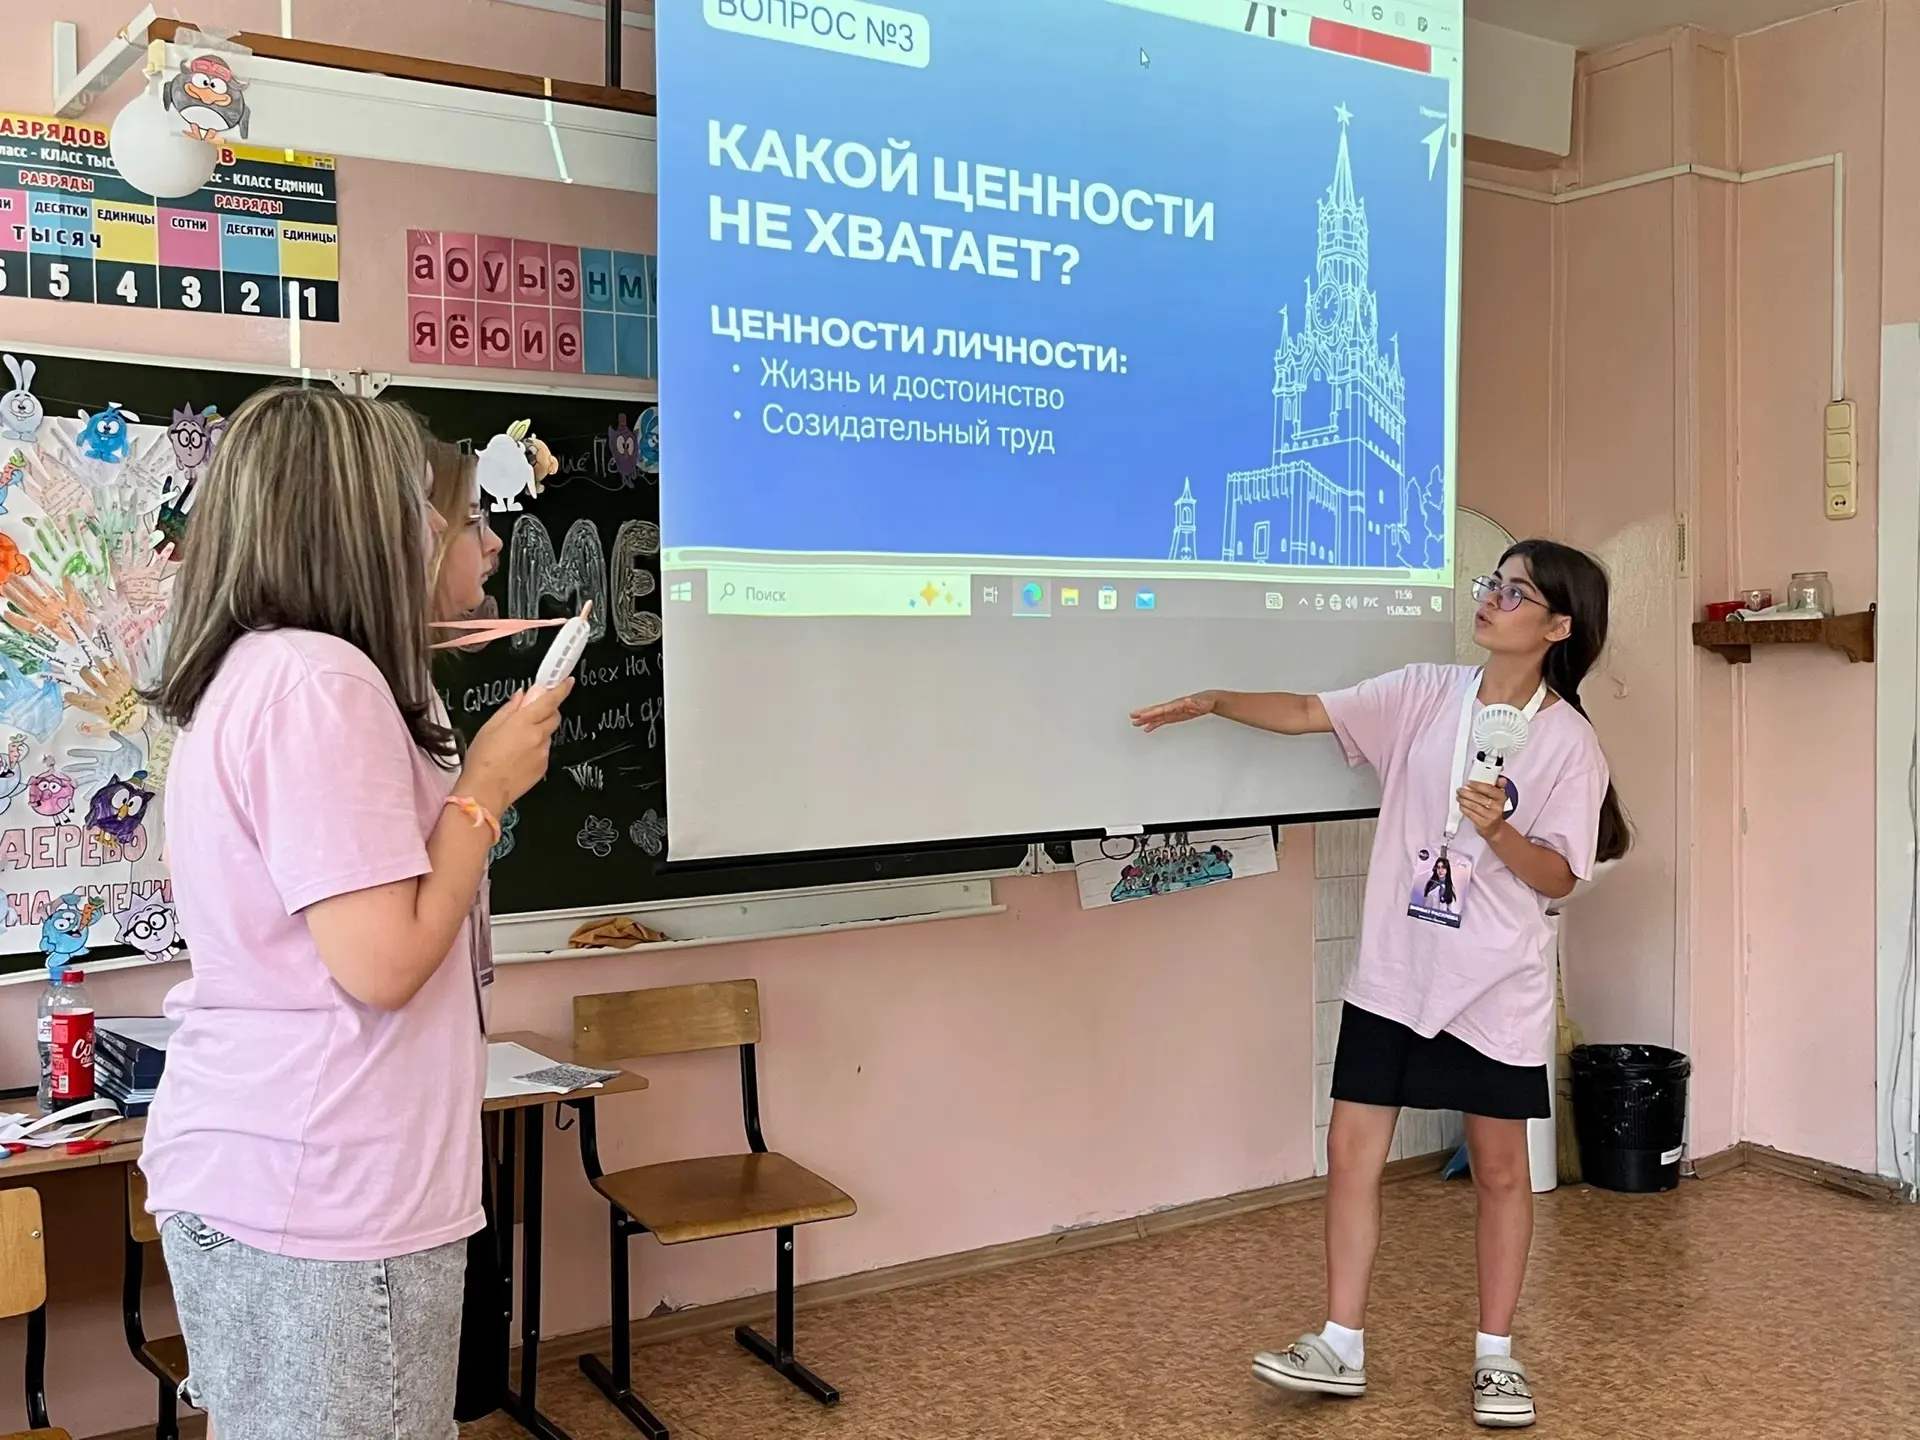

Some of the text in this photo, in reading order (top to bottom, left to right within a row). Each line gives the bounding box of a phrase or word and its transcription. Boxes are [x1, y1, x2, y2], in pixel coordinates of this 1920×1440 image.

[718, 0, 914, 52] ВОПРОС №3
[0, 118, 107, 147] АЗРЯДОВ
[41, 148, 83, 165] КЛАСС
[86, 154, 117, 169] ТЫС
[20, 171, 93, 192] РАЗРЯДЫ
[233, 173, 272, 188] КЛАСС
[274, 178, 324, 196] ЕДИНИЦ
[708, 118, 1215, 241] КАКОЙ ЦЕННОСТИ
[34, 201, 88, 217] ДЕСЯТКИ
[216, 195, 282, 213] РАЗРЯДЫ
[97, 208, 155, 225] ЕДИНИЦЫ
[171, 216, 208, 231] СОТНИ
[226, 223, 275, 238] ДЕСЯТКИ
[283, 228, 336, 243] ЕДИНИЦЫ
[709, 194, 1081, 285] НЕ ХВАТАЕТ?
[49, 263, 317, 318] 5 4 3 2 1
[710, 304, 1128, 374] ЦЕННОСТИ ЛИЧНОСТИ:
[760, 356, 1065, 410] Жизнь и достоинство
[762, 403, 1056, 456] Созидательный труд
[746, 586, 786, 602] Поиск
[1363, 597, 1379, 608] РУС
[1394, 589, 1413, 600] 11:56
